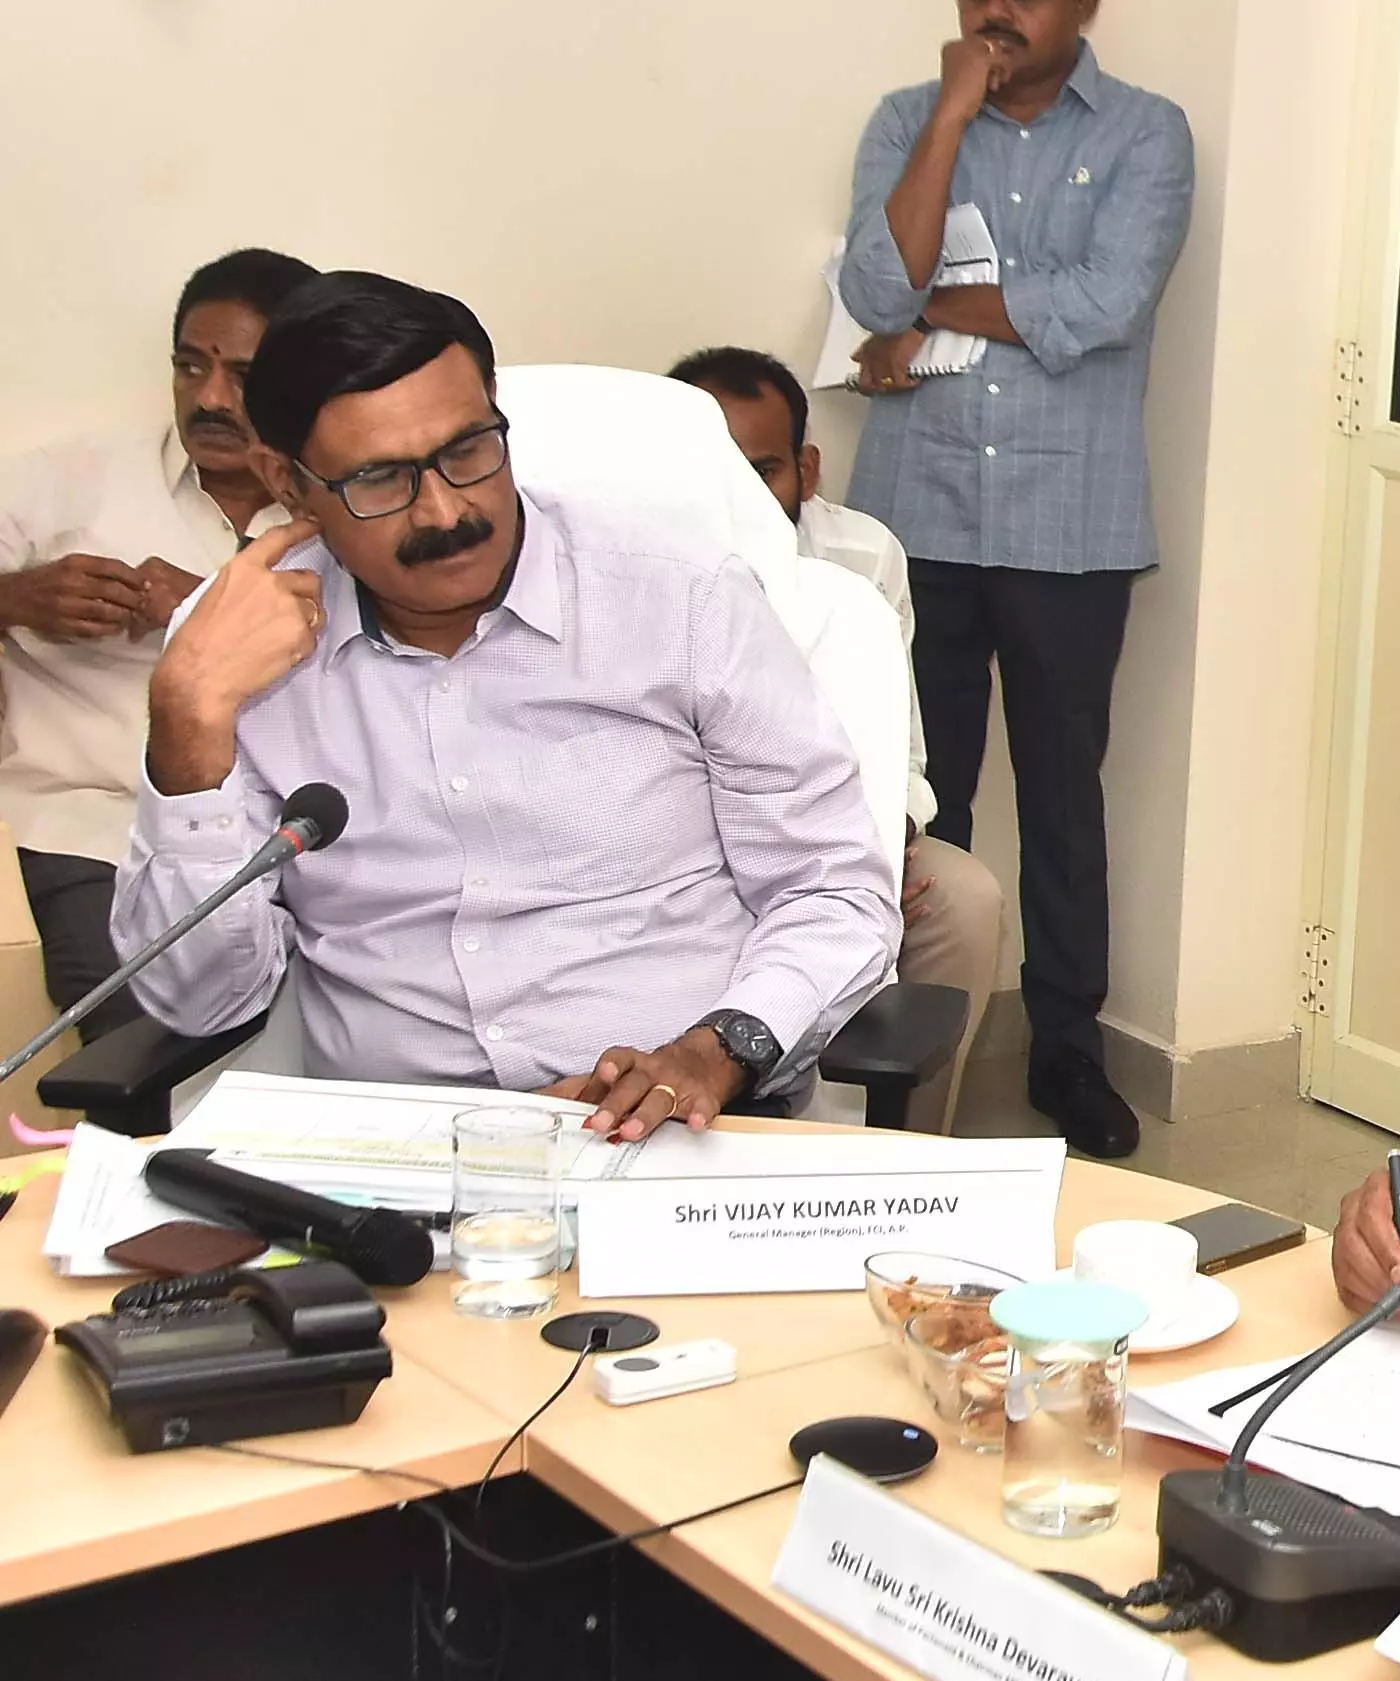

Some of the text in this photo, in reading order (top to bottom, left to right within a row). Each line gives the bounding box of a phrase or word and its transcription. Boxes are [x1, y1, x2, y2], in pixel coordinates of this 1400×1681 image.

[675, 1196, 959, 1223] Shri VIJAY KUMAR YADAV
[827, 1540, 864, 1576] Shri
[863, 1559, 903, 1599] Lavu
[904, 1583, 934, 1615] Sri
[933, 1597, 999, 1653] Krishna
